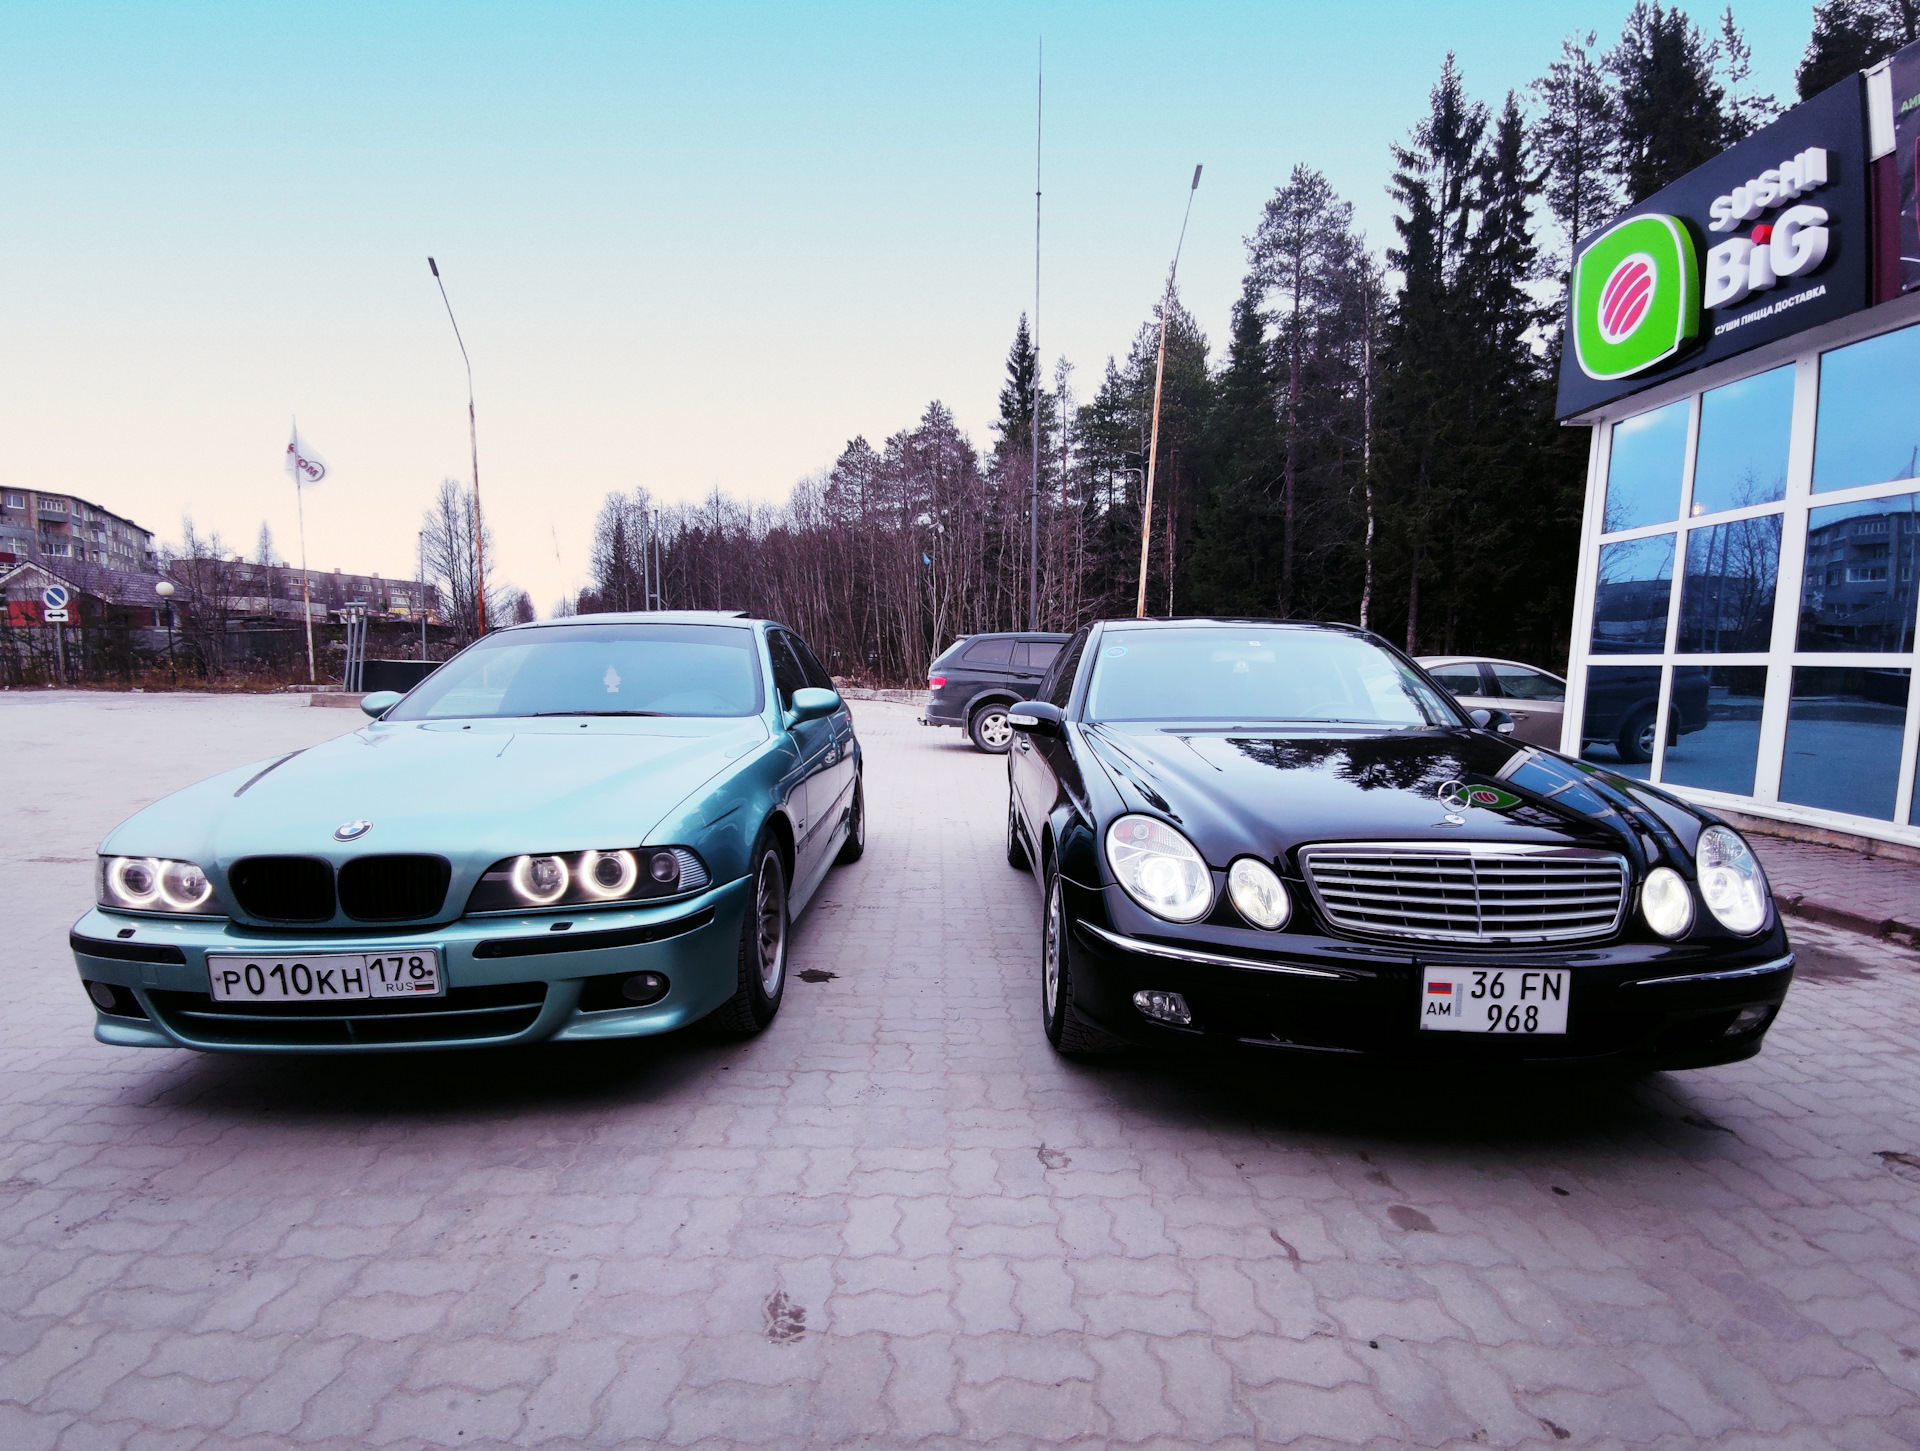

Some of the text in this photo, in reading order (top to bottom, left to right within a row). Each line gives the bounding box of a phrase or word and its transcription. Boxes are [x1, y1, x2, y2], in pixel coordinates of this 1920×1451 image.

[1708, 147, 1827, 232] SUSHI
[1715, 284, 1827, 335] СУШИ ПИЦЦА ДОСТАВКА
[386, 982, 414, 992] RUS
[1471, 971, 1561, 1000] 36 FN
[1426, 1001, 1452, 1016] AM
[1487, 1004, 1539, 1033] 968
